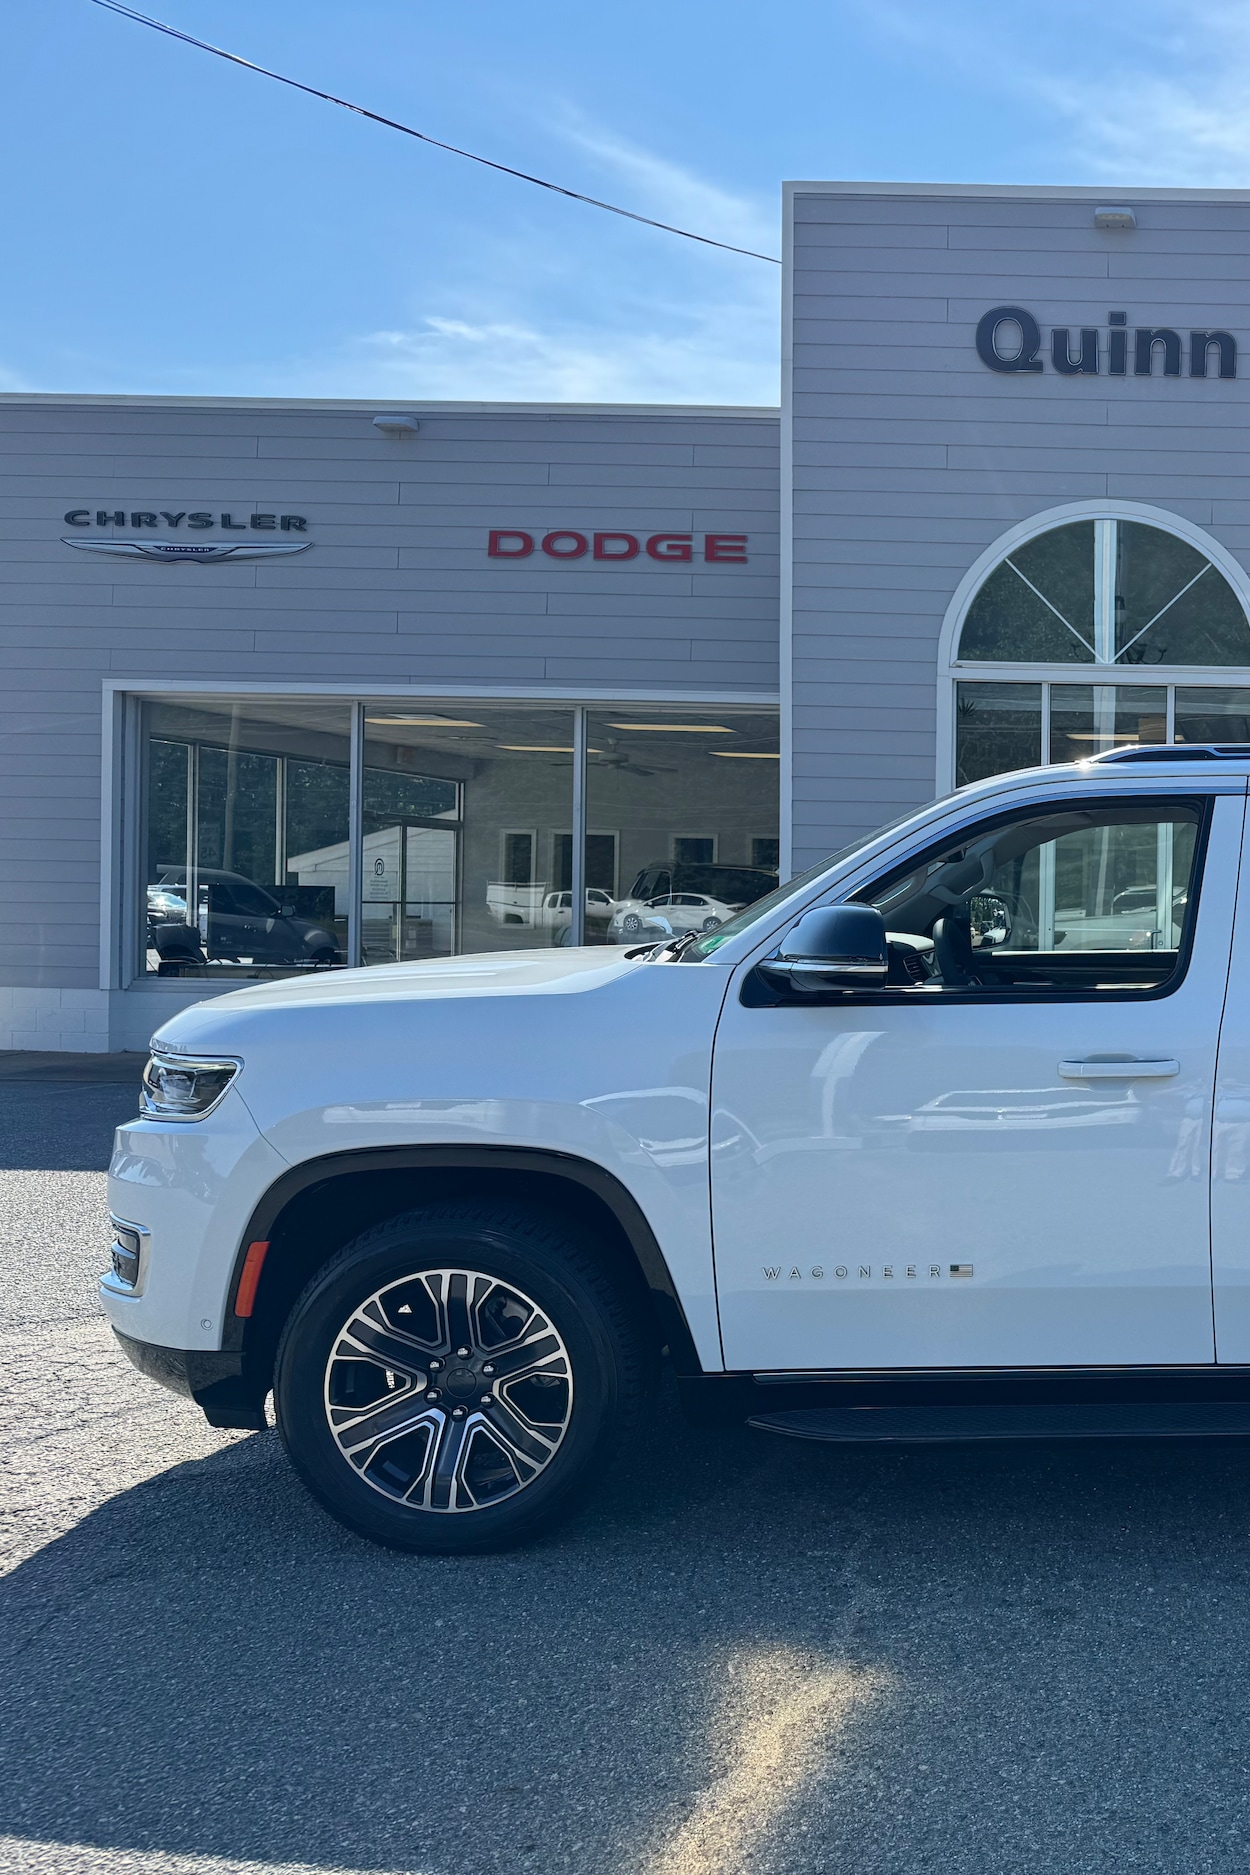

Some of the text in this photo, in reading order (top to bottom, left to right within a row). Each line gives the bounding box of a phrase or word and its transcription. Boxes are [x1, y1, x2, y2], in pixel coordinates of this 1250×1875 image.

[975, 305, 1237, 378] Quinn
[64, 510, 307, 532] CHRYSLER
[487, 530, 748, 564] DODGE
[762, 1264, 941, 1279] WAGONEER
